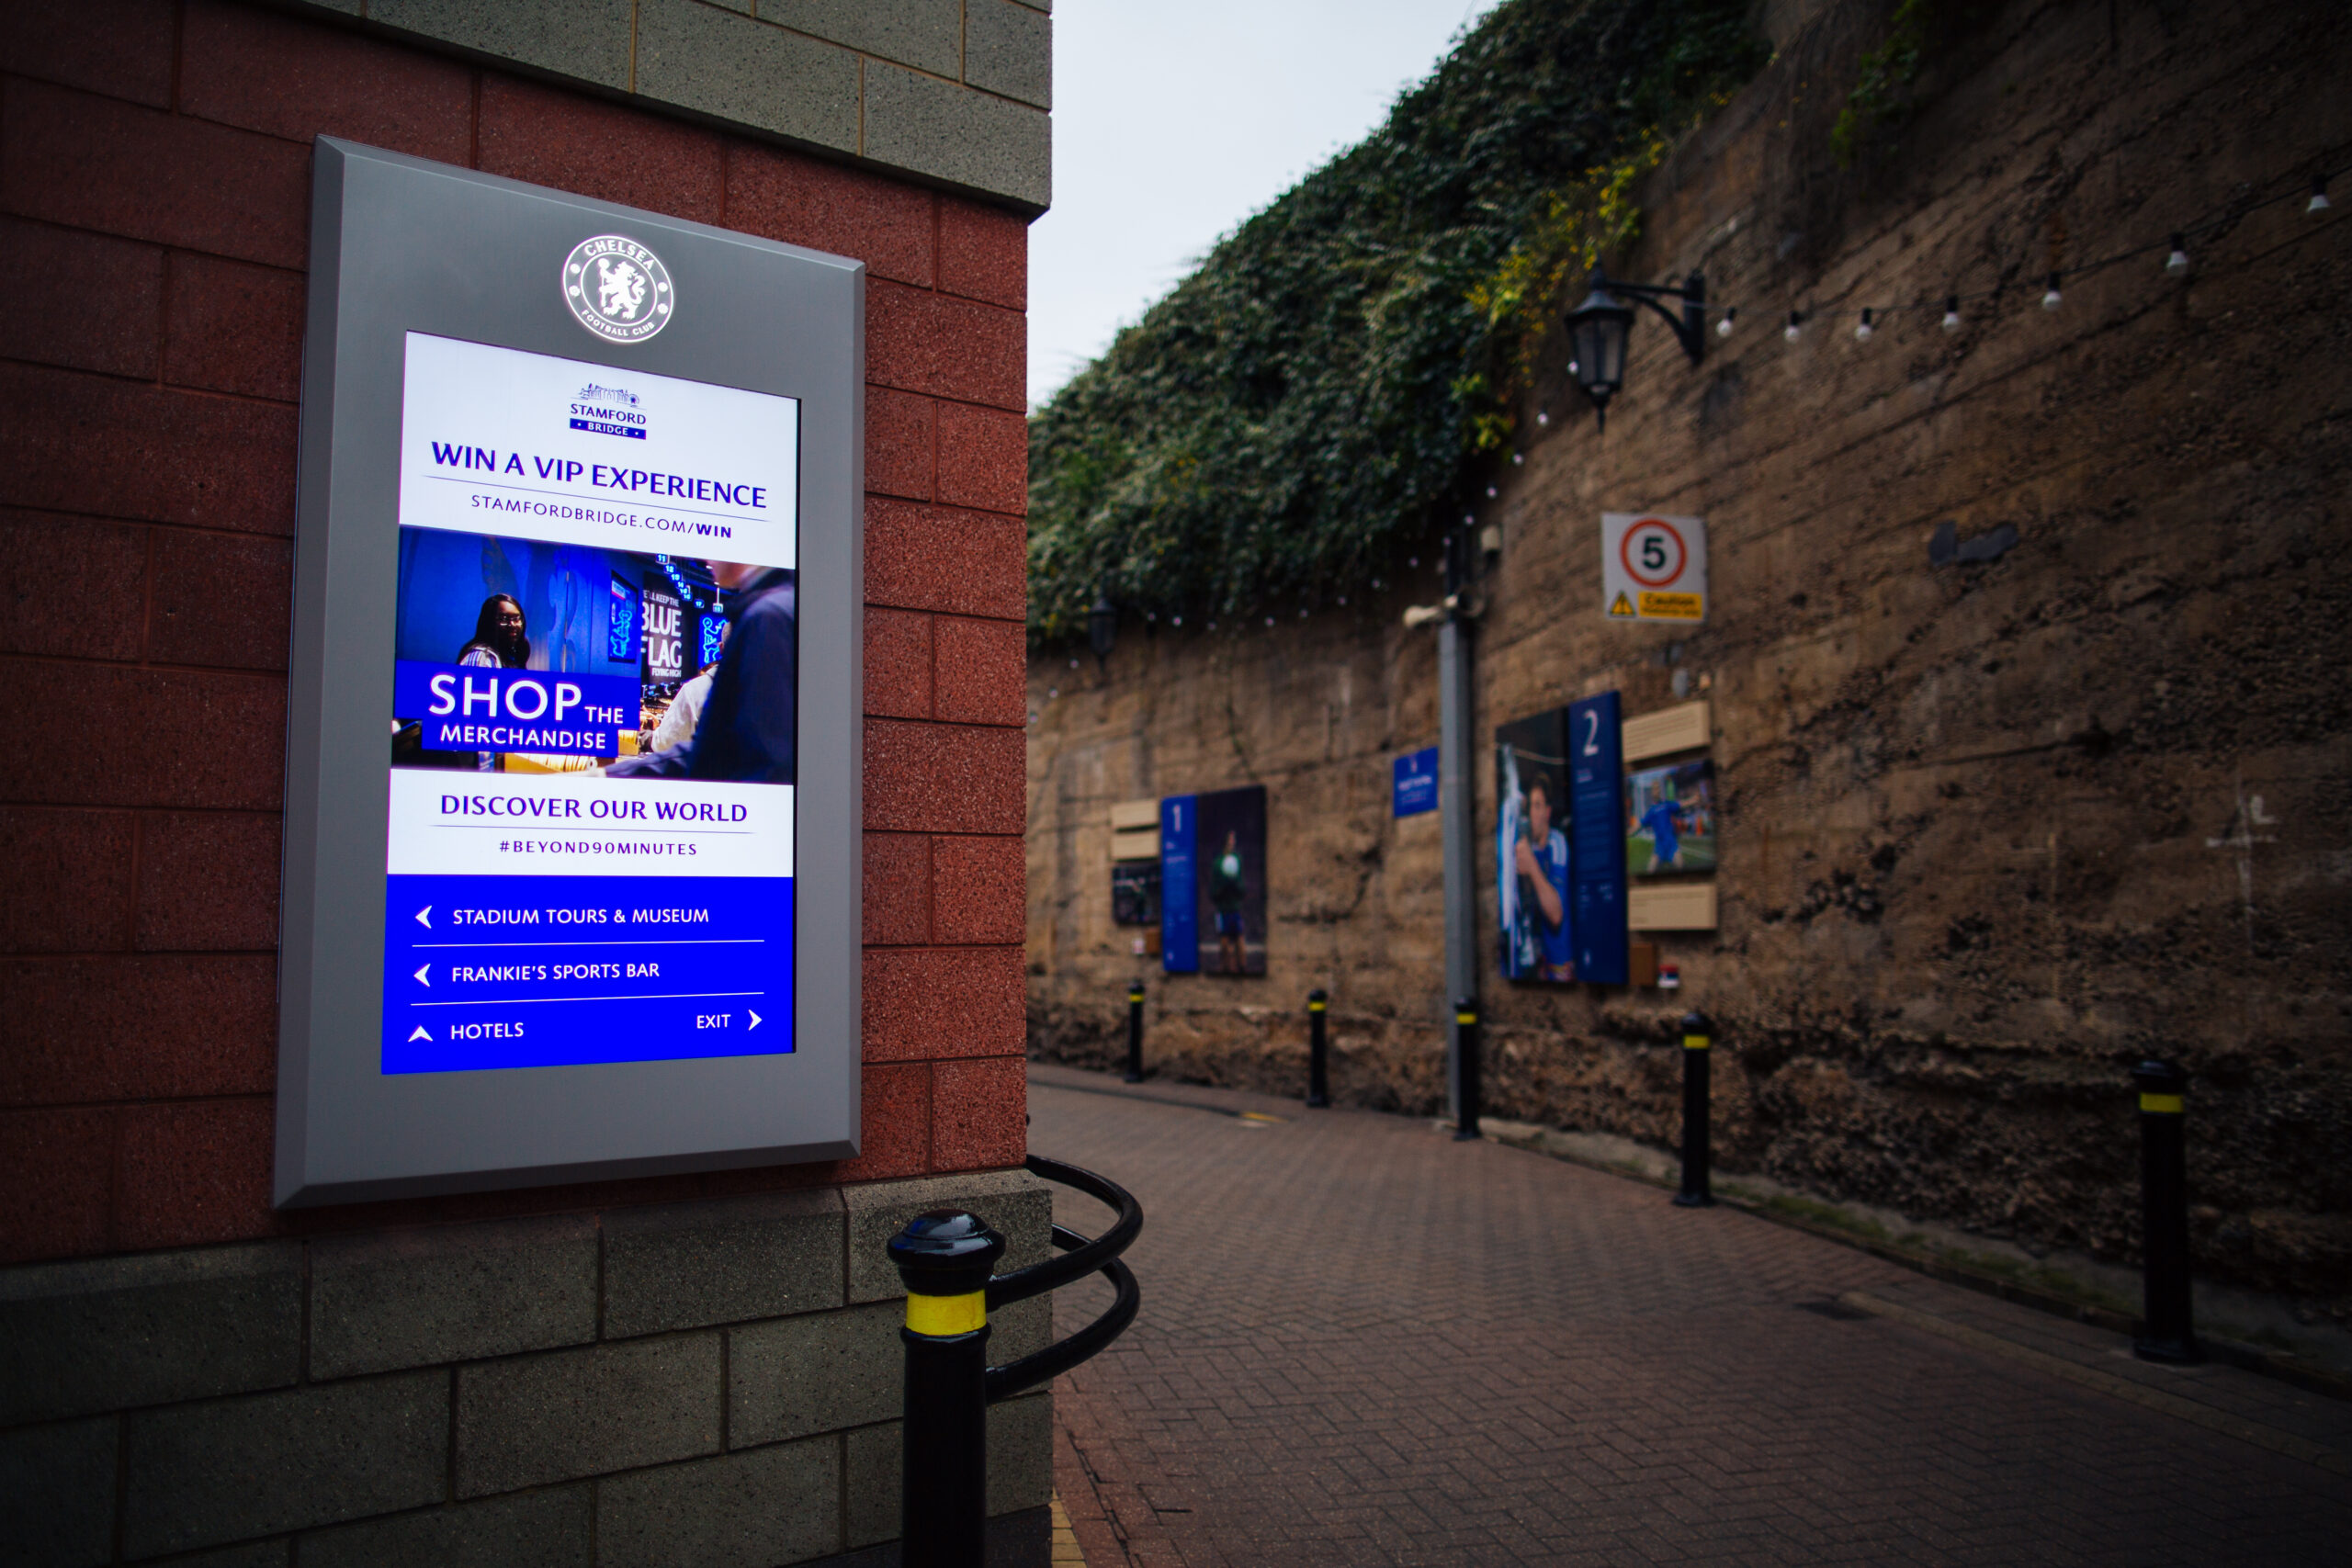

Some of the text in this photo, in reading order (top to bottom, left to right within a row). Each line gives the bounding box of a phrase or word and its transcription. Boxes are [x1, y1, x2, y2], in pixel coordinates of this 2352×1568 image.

[584, 238, 655, 272] CHELSEA
[581, 309, 655, 337] FOOTBALL CLUB
[570, 403, 647, 425] STAMFORD
[587, 422, 628, 436] BRIDGE
[431, 441, 768, 509] WIN A VIP EXPERIENCE
[470, 494, 732, 539] STAMFORDBRIDGE.COM/WIN
[1643, 536, 1666, 570] 5
[428, 673, 623, 725] SHOP THE
[440, 725, 605, 750] MERCHANDISE
[1582, 709, 1600, 756] 2
[441, 794, 747, 823] DISCOVER OUR WORLD
[1172, 804, 1182, 832] 1
[499, 840, 698, 856] #BEYOND90MINUTES
[453, 908, 709, 925] STADIUM TOURS & MUSEUM
[452, 964, 661, 983] FRANKIE'S SPORTS BAR
[451, 1022, 525, 1041] HOTELS
[696, 1014, 731, 1030] EXIT
